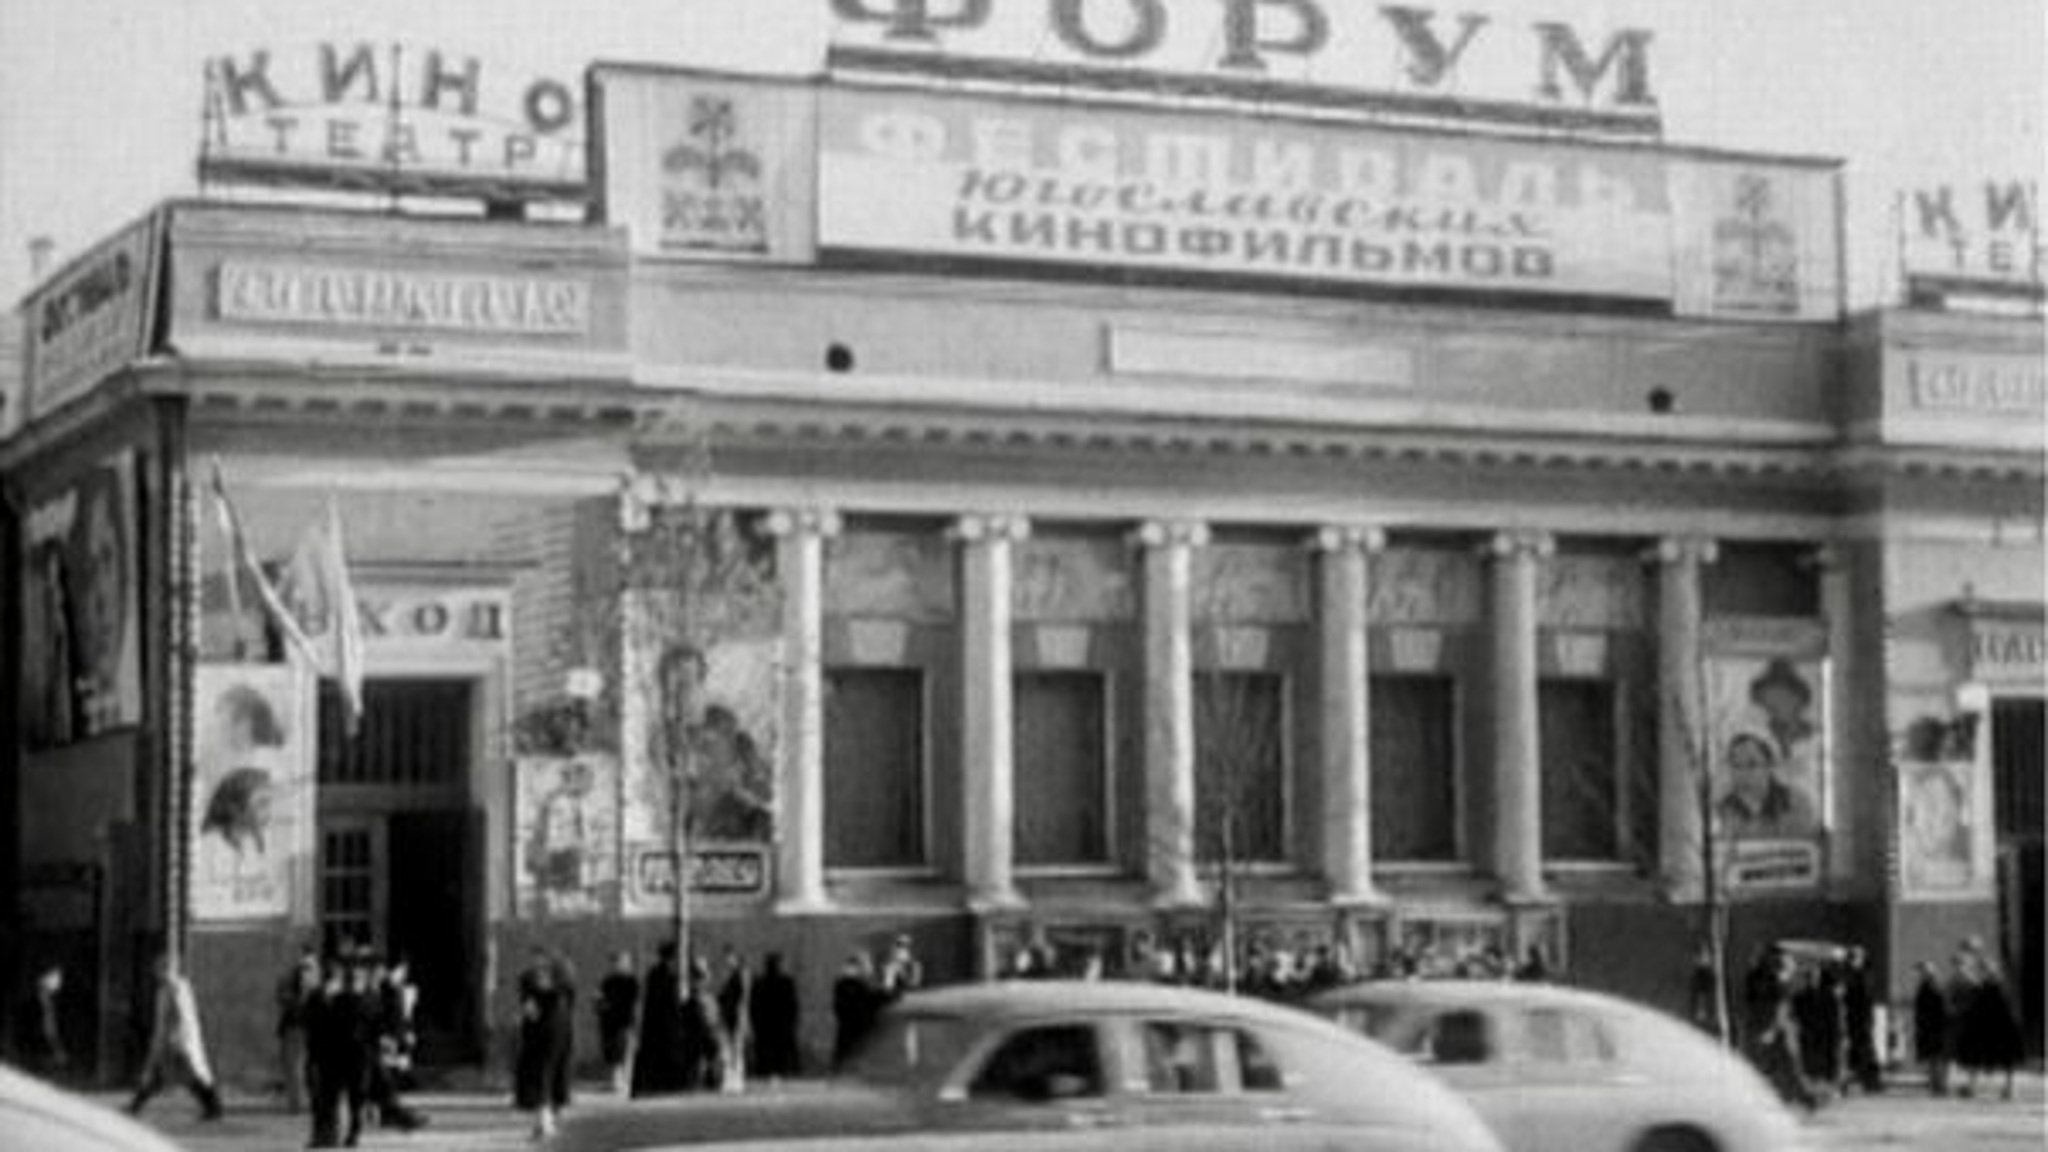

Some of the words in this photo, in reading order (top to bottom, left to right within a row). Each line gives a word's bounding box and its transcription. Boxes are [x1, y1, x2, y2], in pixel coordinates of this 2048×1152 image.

[217, 42, 574, 134] КИНО
[265, 116, 537, 168] ТЕАТР
[860, 111, 1636, 214] ФЕСТИВАЛЬ
[957, 168, 1551, 238] Югославских
[951, 205, 1555, 278] КИНОФИЛЬМОВ
